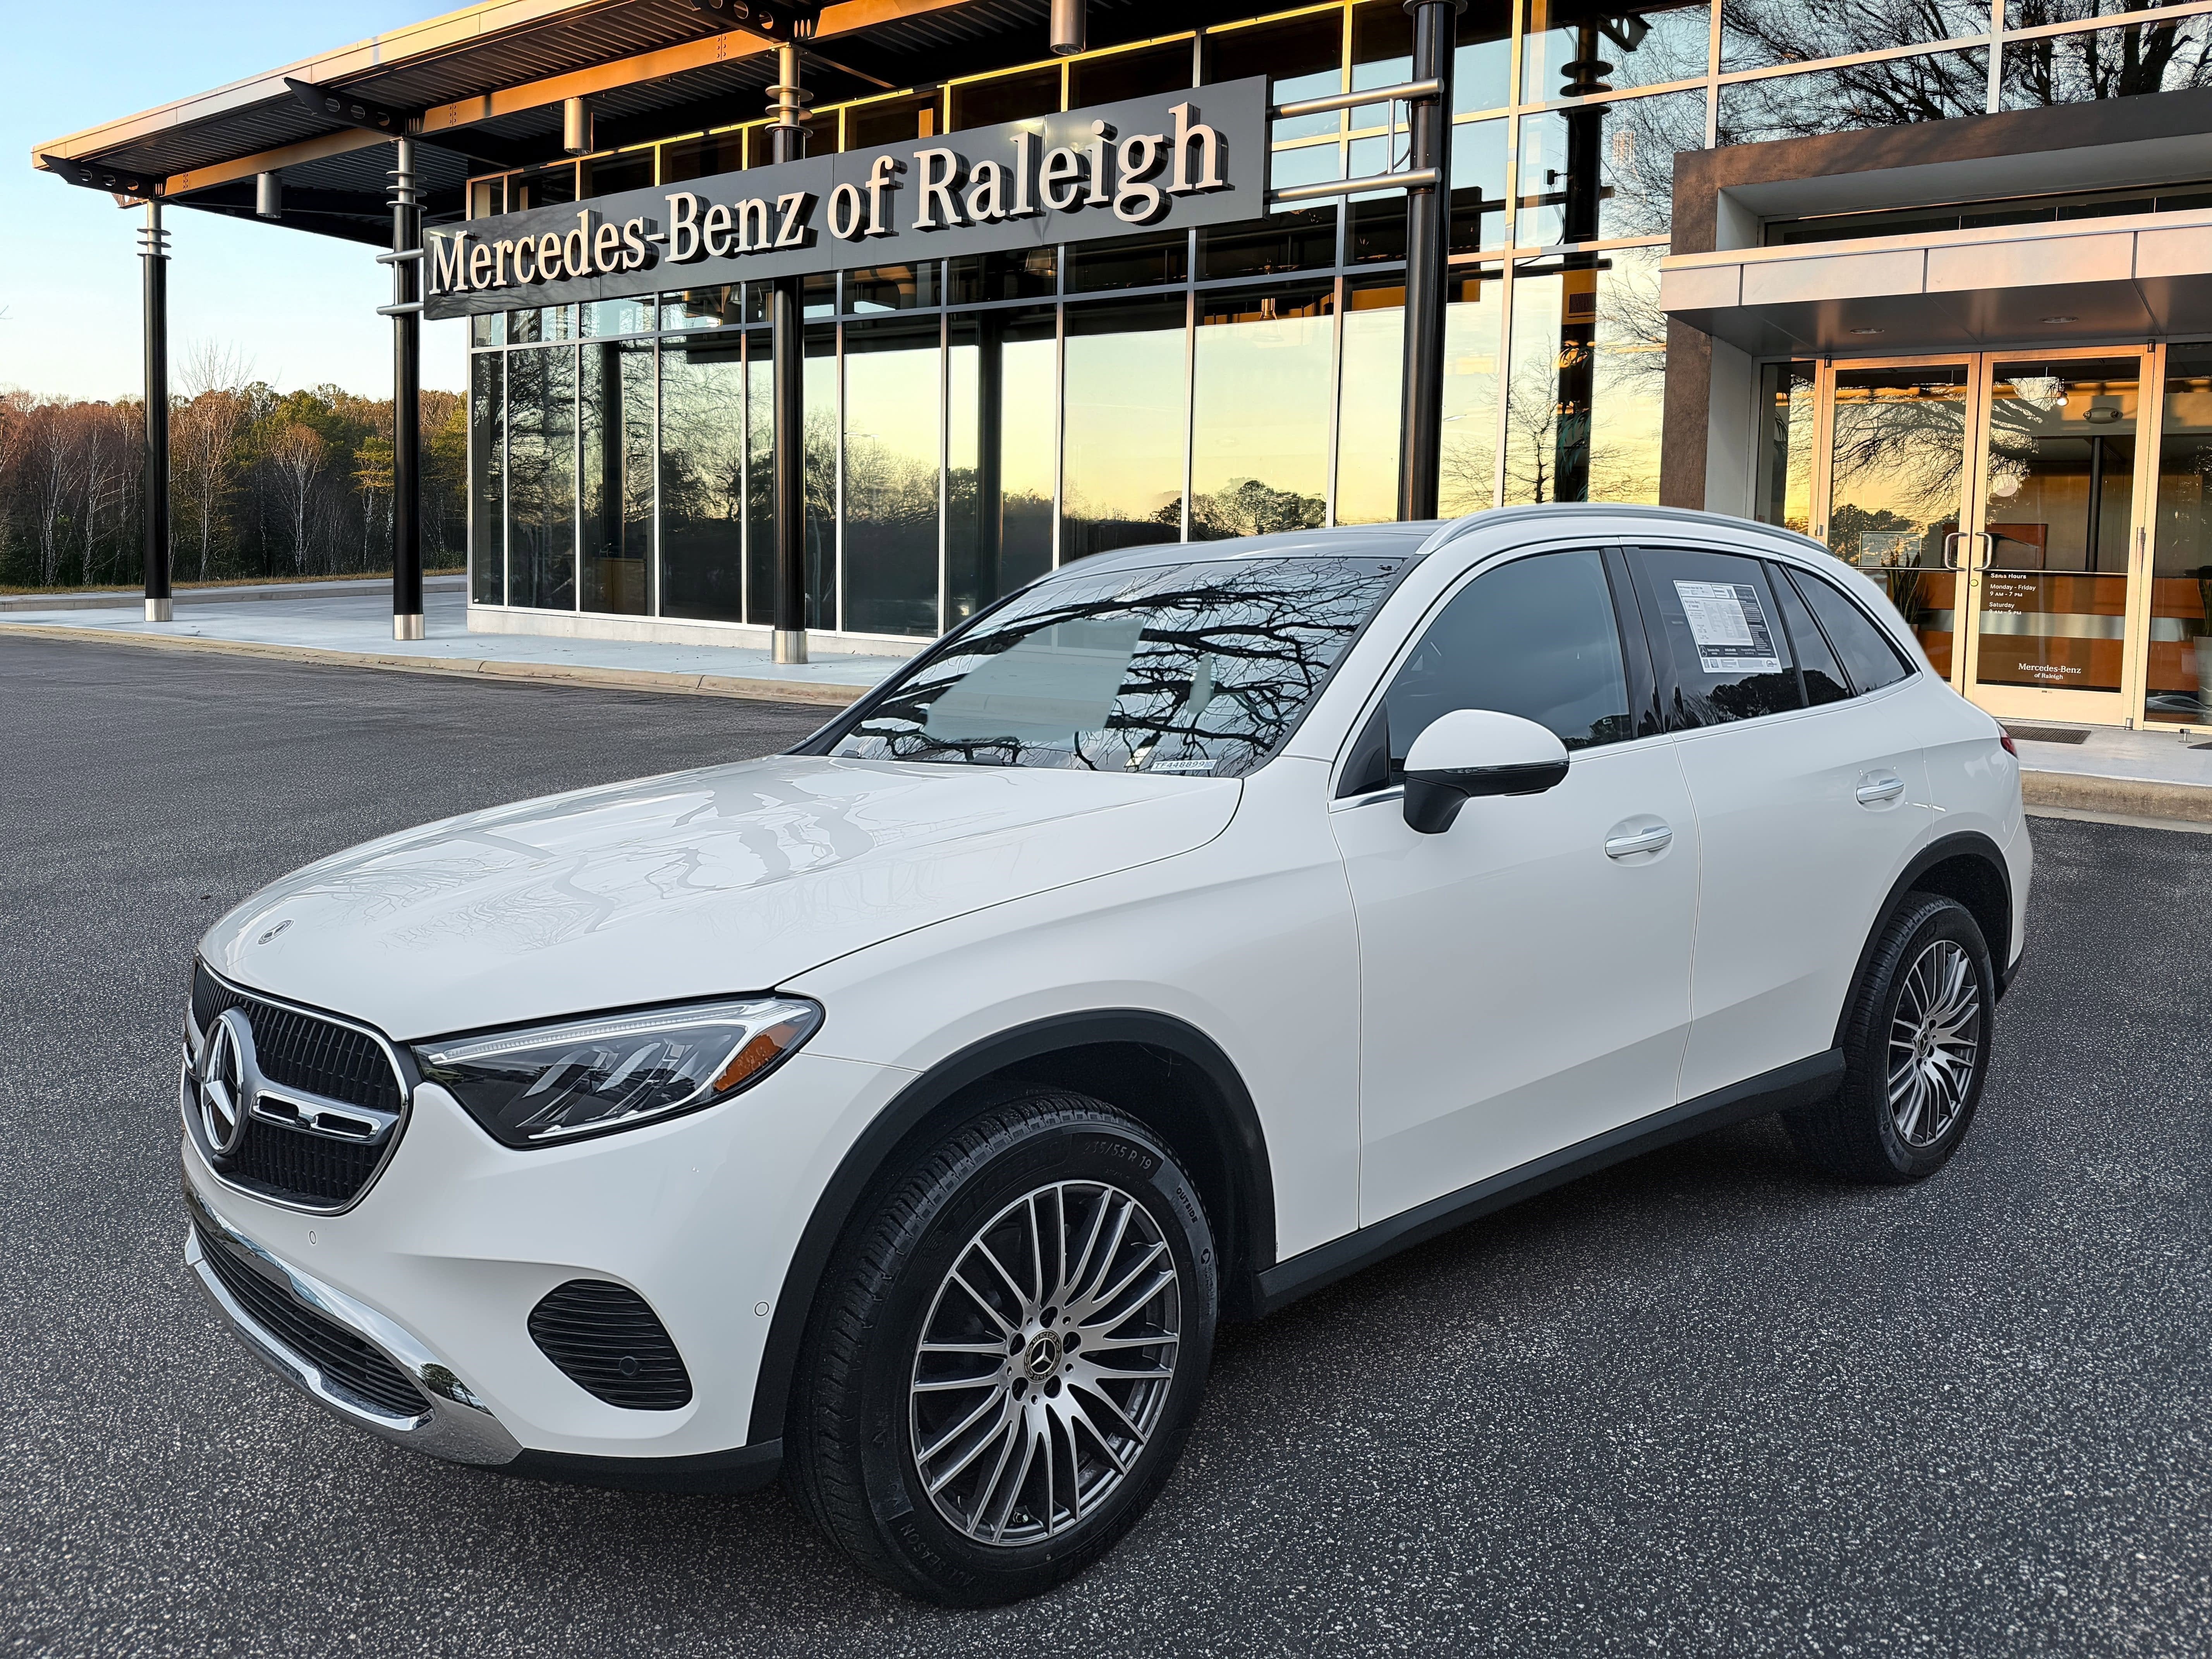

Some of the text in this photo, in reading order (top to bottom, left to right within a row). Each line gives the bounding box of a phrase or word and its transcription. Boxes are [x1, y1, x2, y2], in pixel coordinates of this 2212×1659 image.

[428, 101, 1224, 295] Mercedes-Benz of Raleigh
[2018, 663, 2081, 673] Mercedes-Benz
[1128, 1150, 1137, 1162] R
[1139, 1156, 1152, 1169] 19
[1176, 1187, 1197, 1224] OUTSIDE
